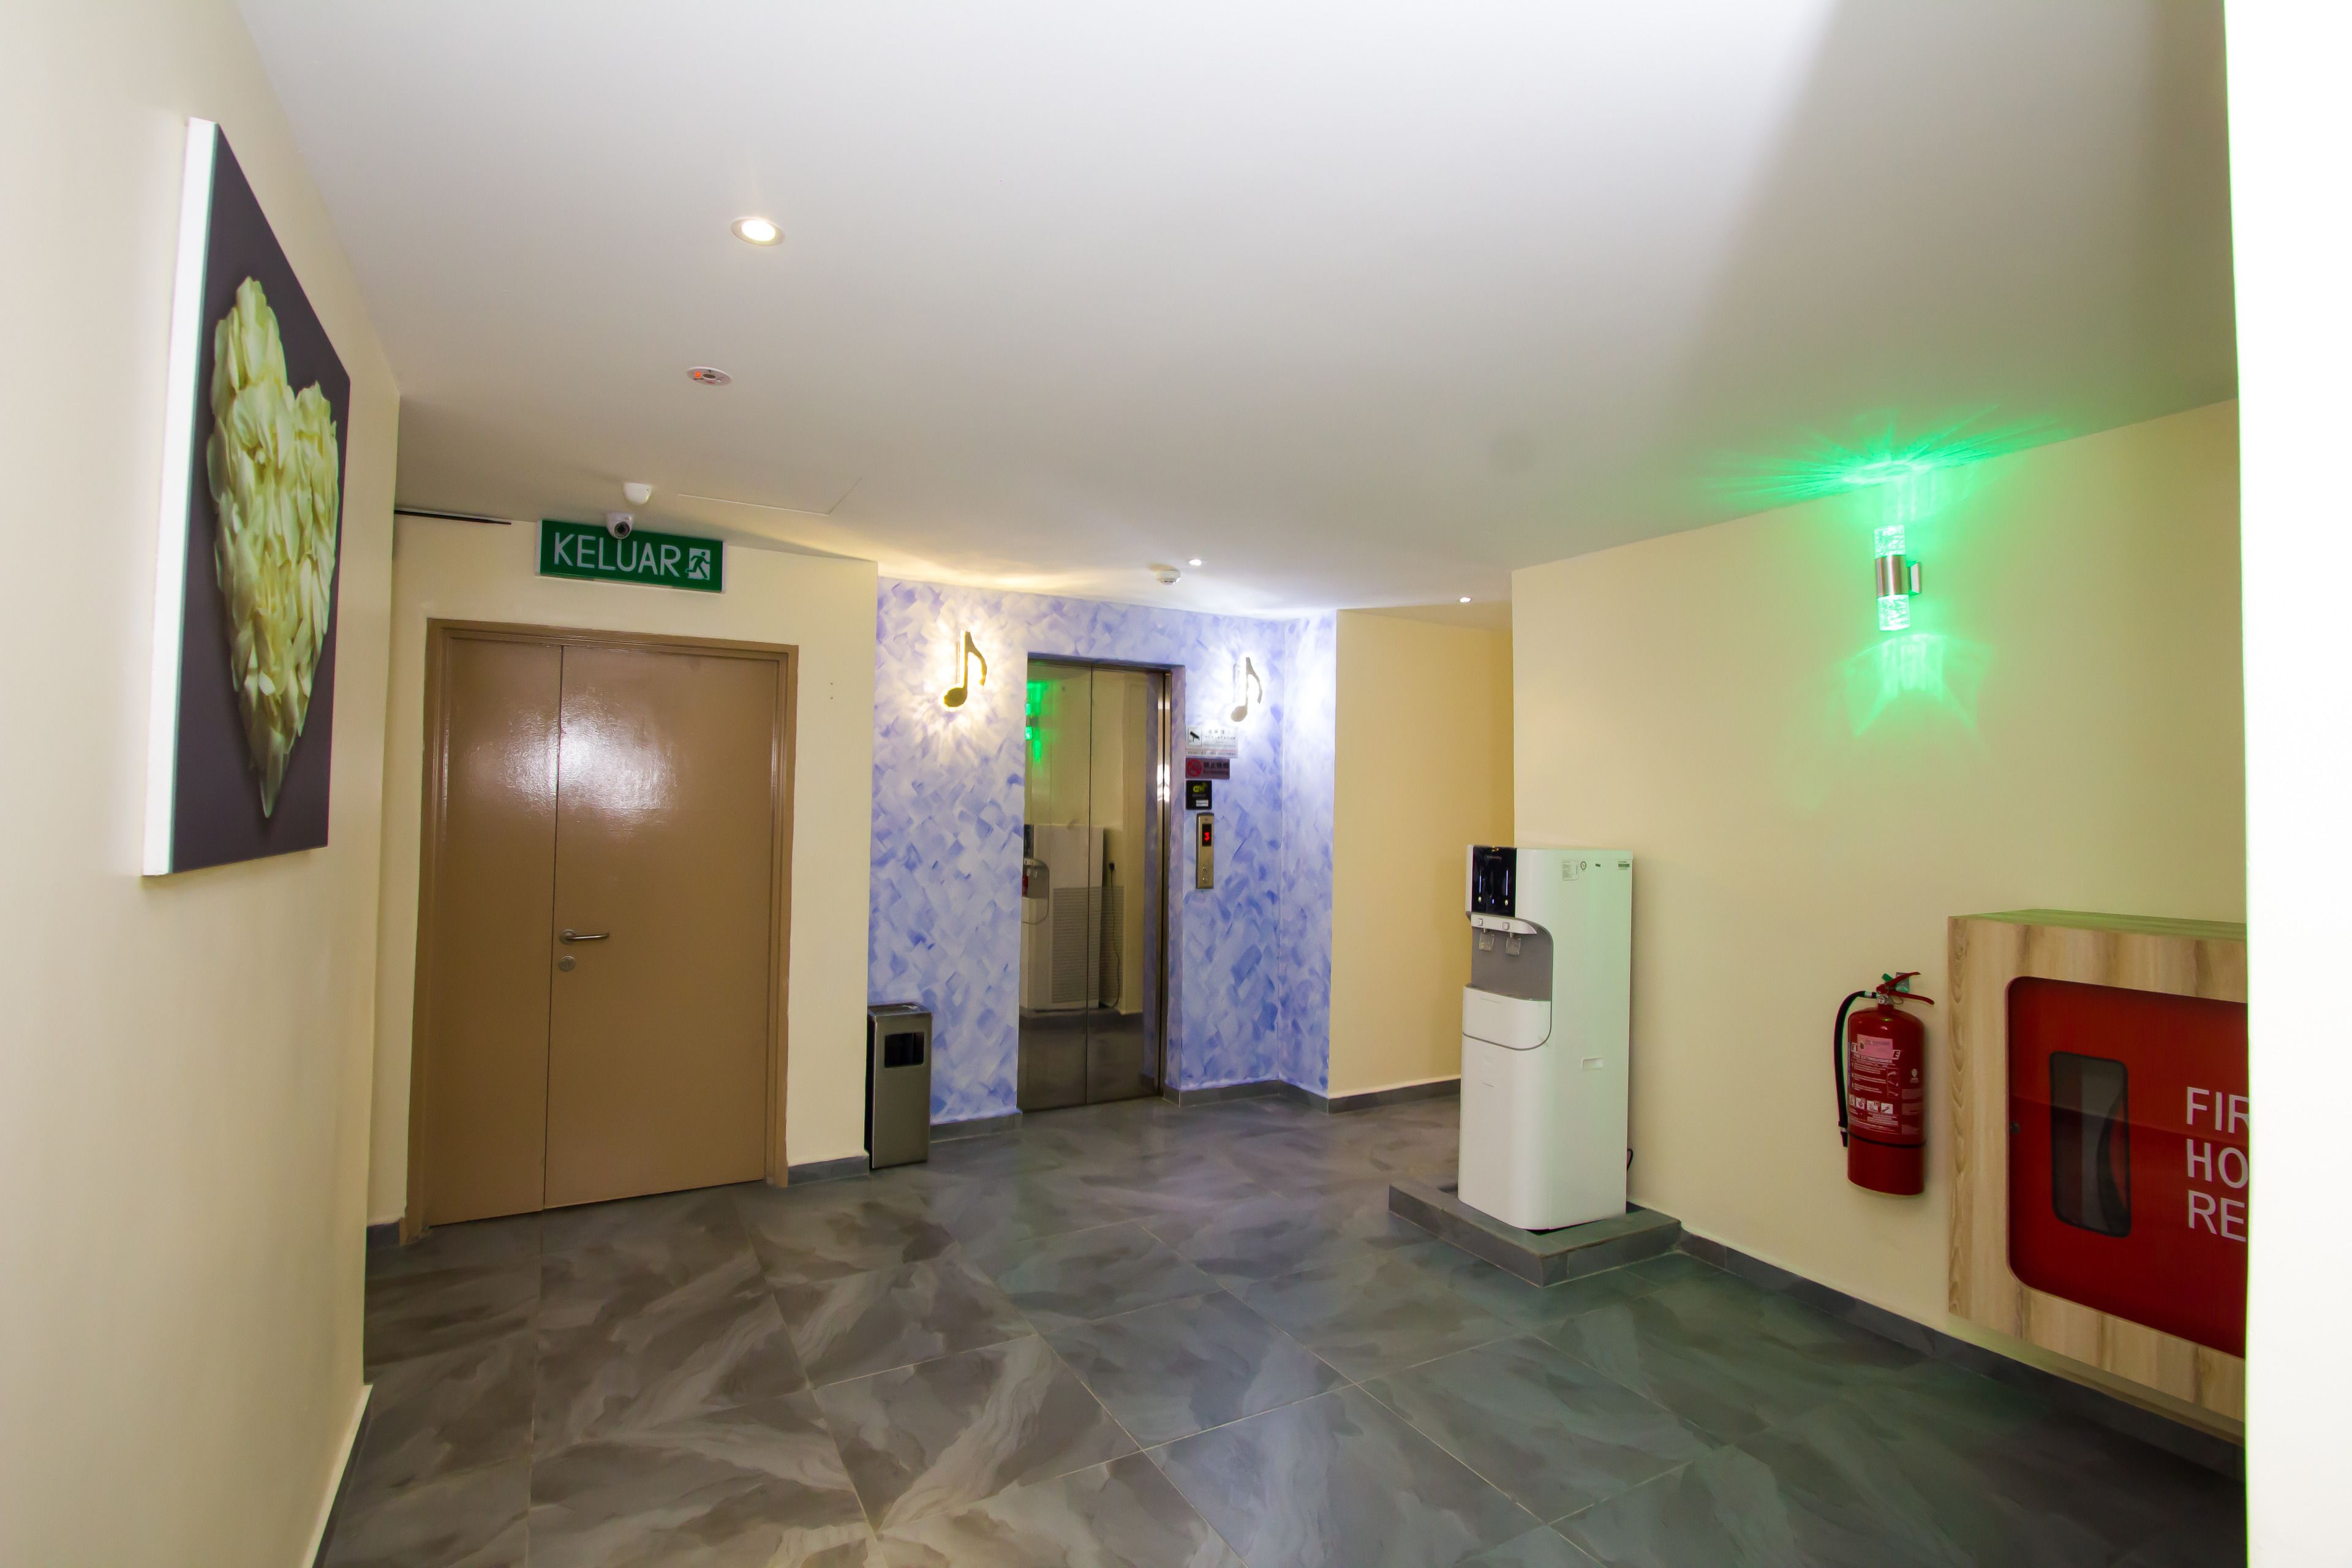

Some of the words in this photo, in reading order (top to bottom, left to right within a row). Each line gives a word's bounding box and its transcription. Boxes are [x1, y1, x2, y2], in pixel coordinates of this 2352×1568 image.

[554, 532, 680, 577] KELUAR
[2186, 1138, 2249, 1189] HO
[2188, 1189, 2247, 1243] RE
